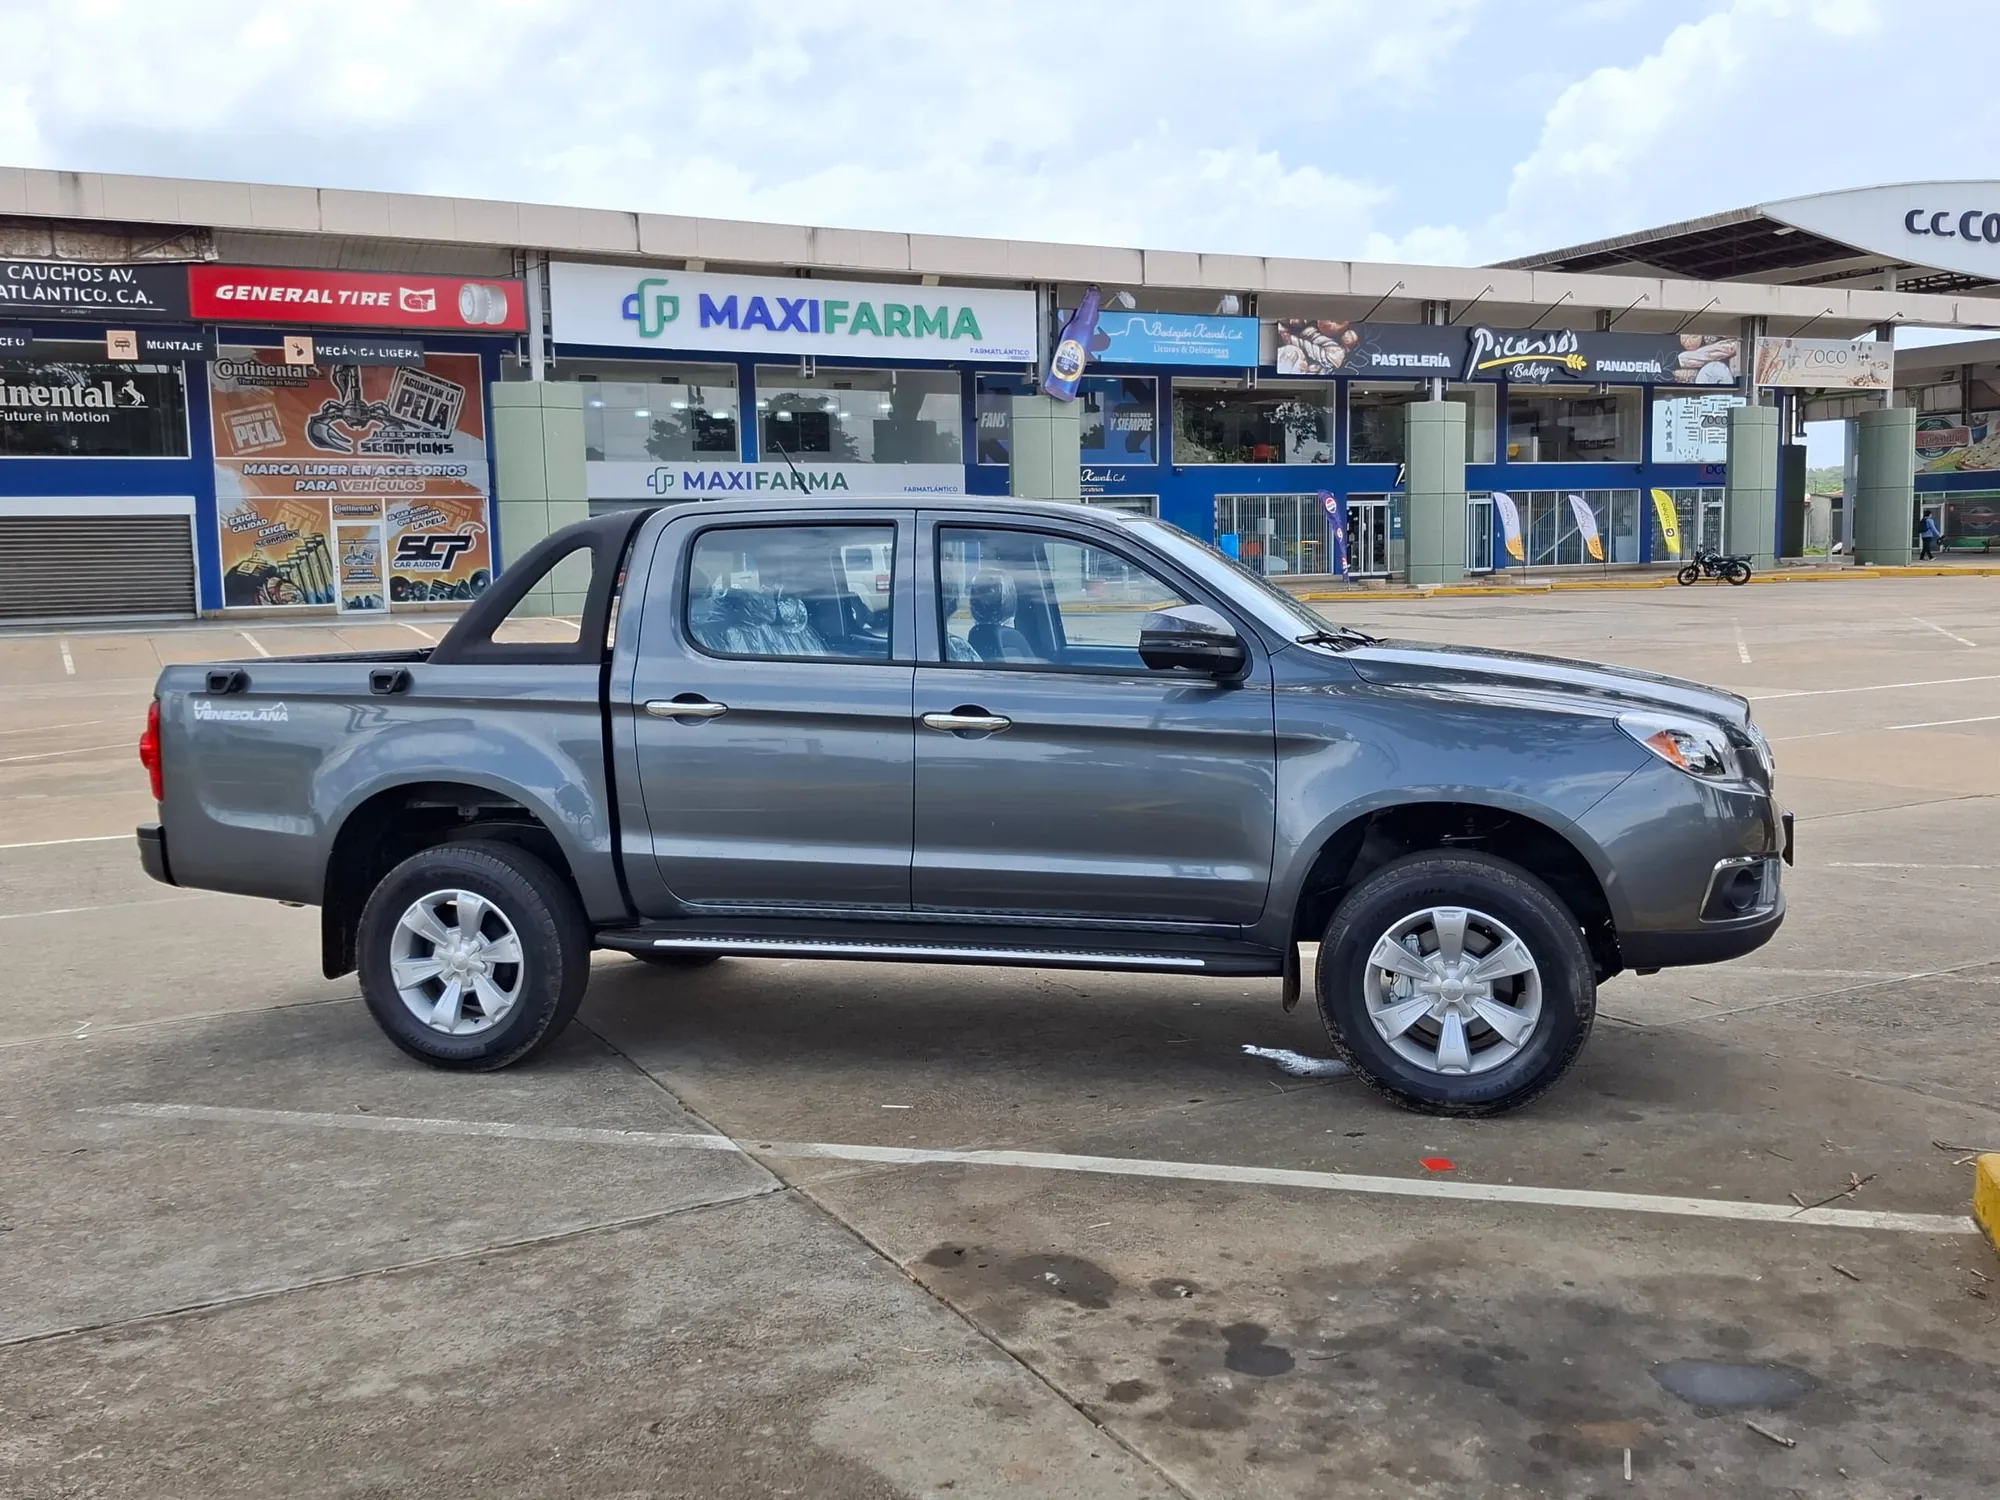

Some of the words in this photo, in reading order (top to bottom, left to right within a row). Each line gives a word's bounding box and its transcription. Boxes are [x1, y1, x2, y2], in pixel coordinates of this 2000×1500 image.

[7, 265, 104, 282] CAUCHOS
[109, 268, 137, 284] AV.
[117, 290, 154, 304] C.A.
[216, 285, 333, 304] GENERAL
[338, 291, 392, 306] TIRE
[700, 293, 983, 340] MAXIFARMA
[146, 340, 204, 351] MONTAJE
[970, 348, 1030, 356] FARMATLÁNTICO
[379, 348, 420, 358] LIGERA
[1371, 352, 1450, 368] PASTELERÍA
[1804, 349, 1848, 367] ZOCO
[214, 359, 308, 379] Continental
[1513, 362, 1551, 382] Bakery
[1596, 359, 1662, 373] PANADERÍA
[446, 391, 455, 402] LA
[394, 388, 450, 431] PELA
[46, 411, 58, 422] in
[62, 412, 110, 423] Motion
[980, 412, 1006, 428] FANS
[1110, 418, 1116, 431] Y
[1117, 418, 1153, 431] SIEMPRE
[233, 420, 281, 448] PELA
[243, 463, 300, 476] MARCA
[304, 464, 349, 476] LIDER
[352, 465, 372, 476] EN
[373, 465, 467, 476] ACCESORIOS
[295, 480, 338, 491] PARA
[341, 478, 425, 492] VEHÍCULOS
[683, 471, 849, 490] MAXIFARMA
[903, 485, 958, 493] FARMATLÁNTICO
[396, 510, 409, 518] CAR
[410, 505, 429, 514] AUDIO
[228, 512, 258, 526] EXIGE
[232, 519, 268, 533] CALIDAD
[413, 521, 424, 531] LA
[426, 516, 447, 527] PELA
[259, 524, 286, 537] EXIGE
[194, 701, 212, 710] LA
[193, 710, 288, 722] VENEZOLANA
